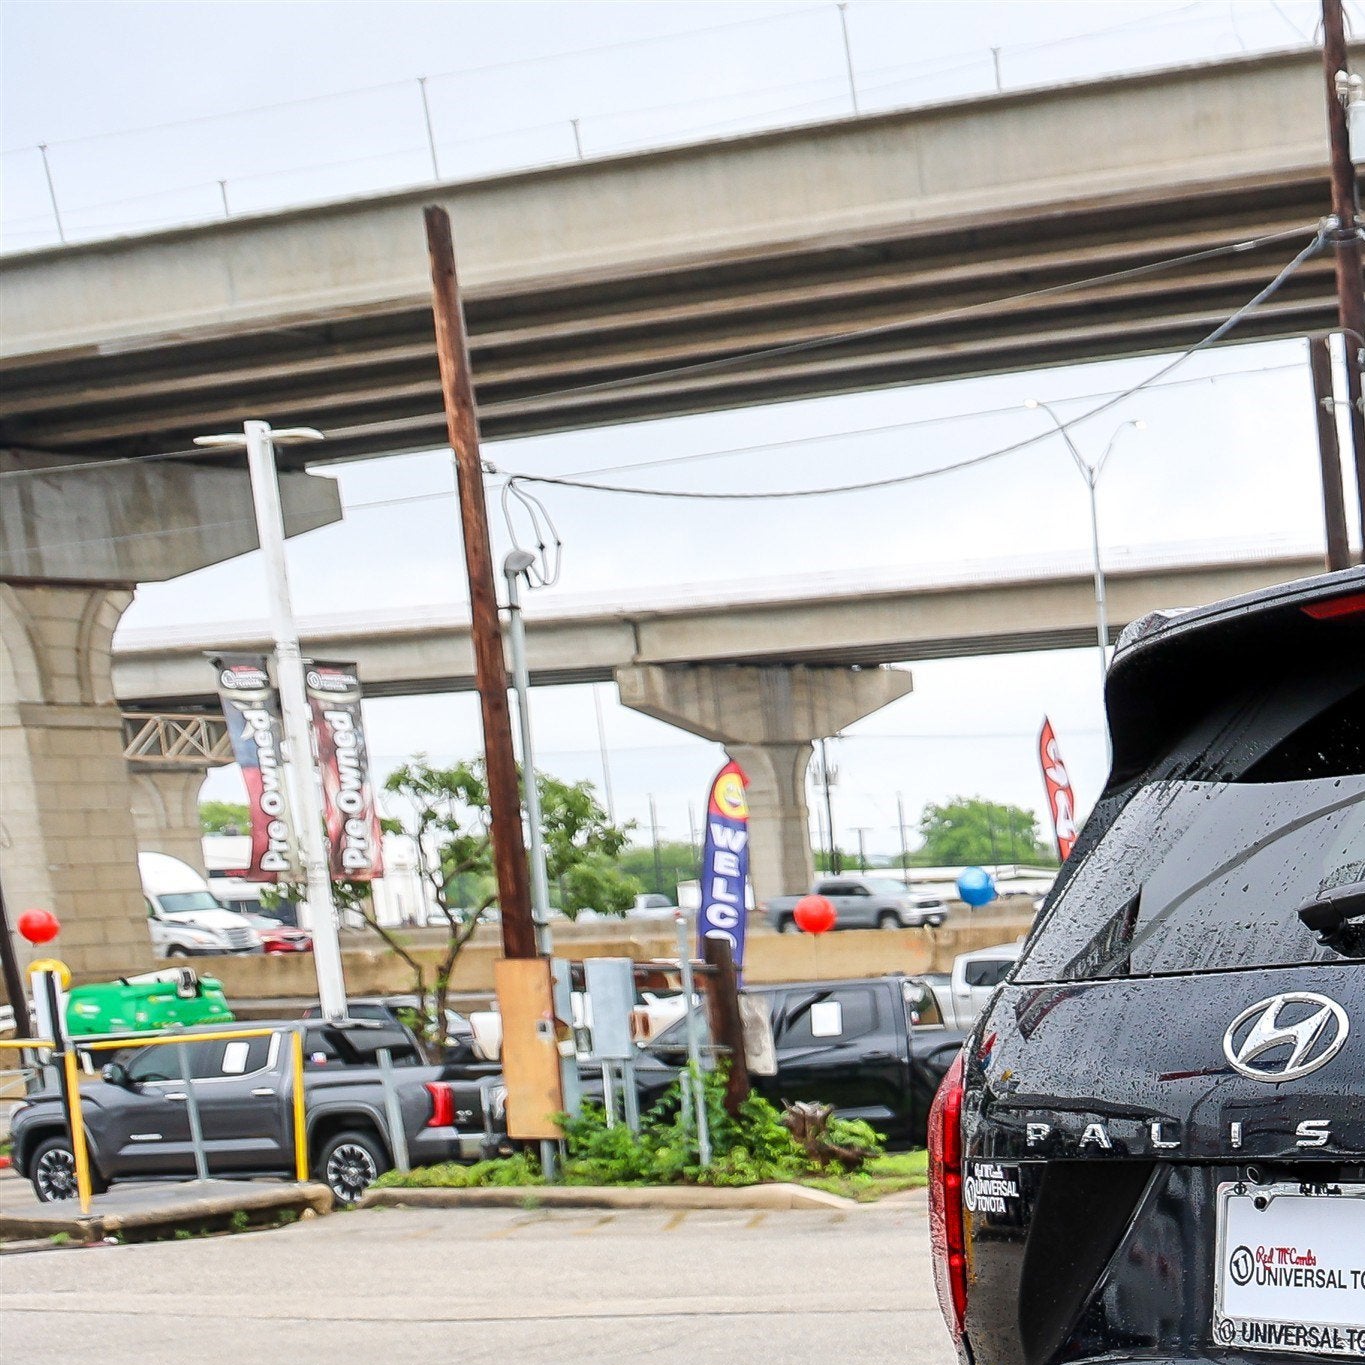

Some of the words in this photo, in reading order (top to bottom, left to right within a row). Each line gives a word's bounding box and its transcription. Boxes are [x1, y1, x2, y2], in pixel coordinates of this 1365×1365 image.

[1046, 738, 1076, 850] SA
[975, 1179, 1020, 1197] UNIVERSAL
[976, 1196, 1006, 1213] TOYOTA
[1256, 1267, 1347, 1289] UNIVERSAL
[1241, 1322, 1345, 1349] UNIVERSAL
